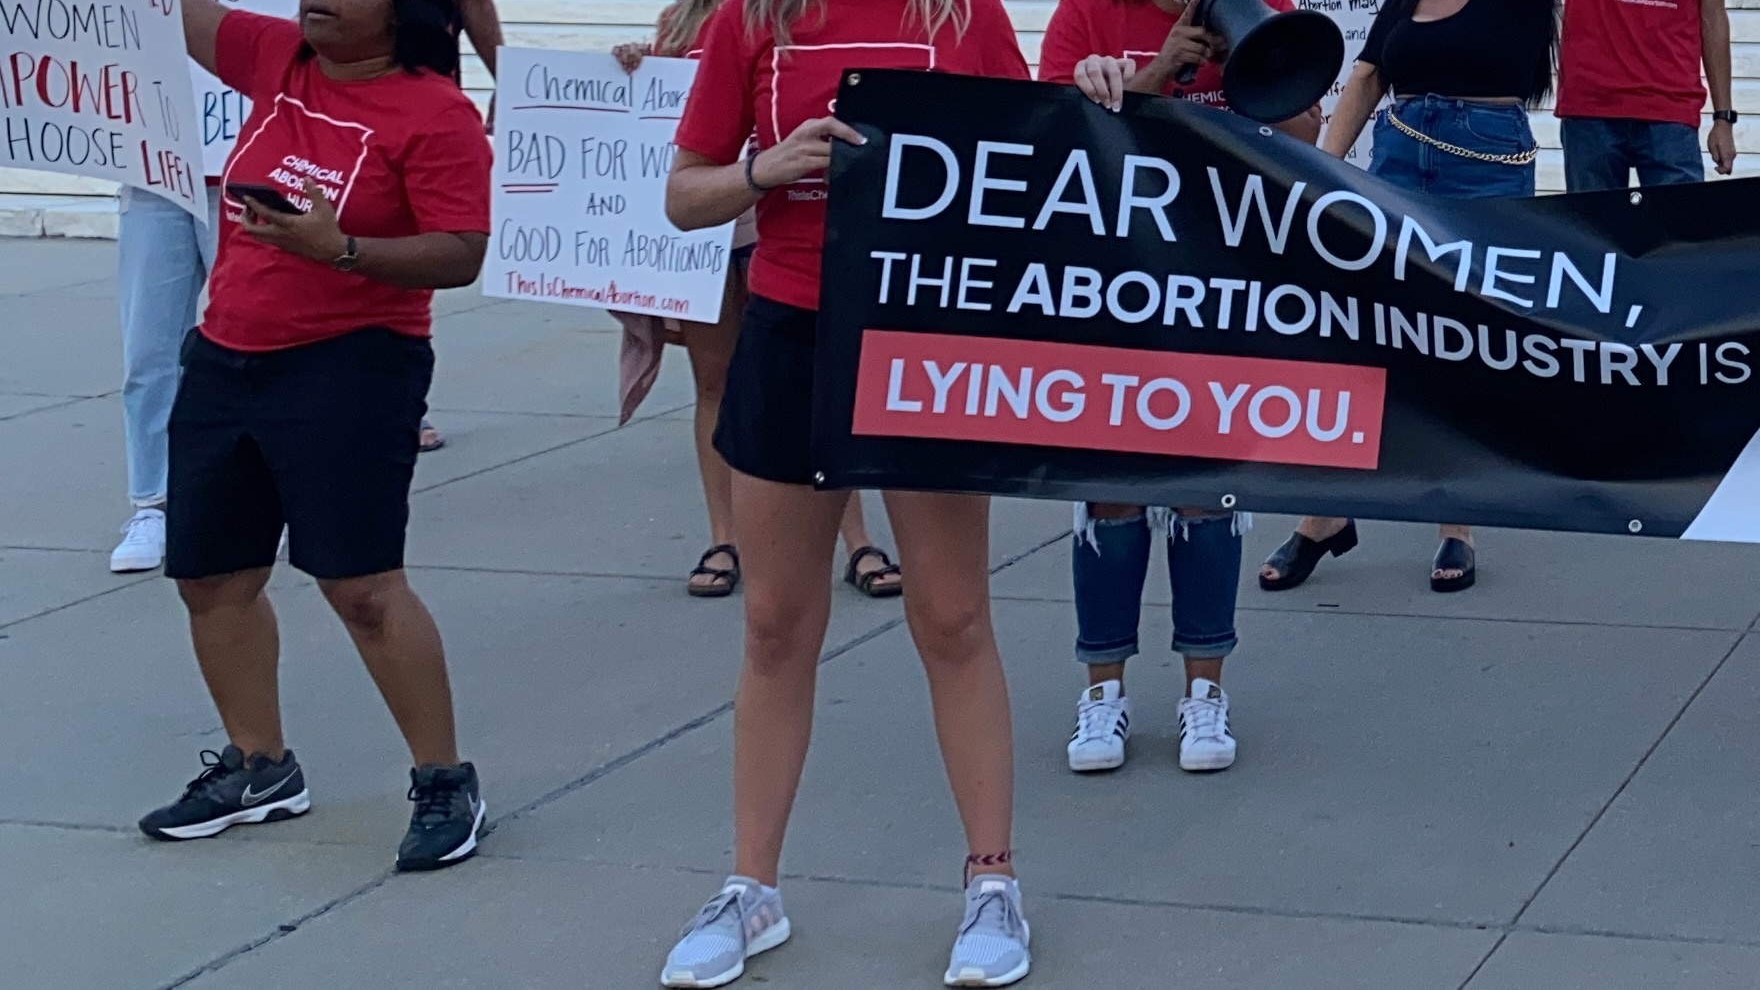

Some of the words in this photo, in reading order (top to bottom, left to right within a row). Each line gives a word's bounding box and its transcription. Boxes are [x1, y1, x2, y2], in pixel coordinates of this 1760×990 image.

[1344, 26, 1366, 41] and
[525, 63, 634, 108] Chemical
[508, 129, 566, 180] BAD
[581, 136, 627, 181] FOR
[586, 192, 626, 216] AND
[882, 132, 1182, 243] DEAR
[1206, 165, 1643, 328] WOMEN,
[499, 217, 561, 262] GOOD
[574, 230, 610, 267] FOR
[621, 229, 726, 275] ABORTIONISTS
[505, 270, 690, 314] ThisIsChemicalAbortion.com
[870, 250, 998, 311] THE
[1006, 262, 1360, 341] ABORTION
[1374, 301, 1683, 387] INDUSTRY
[1699, 342, 1752, 386] IS
[885, 357, 1086, 423] LYING
[1101, 373, 1192, 431] TO
[1207, 381, 1365, 445] YOU.
